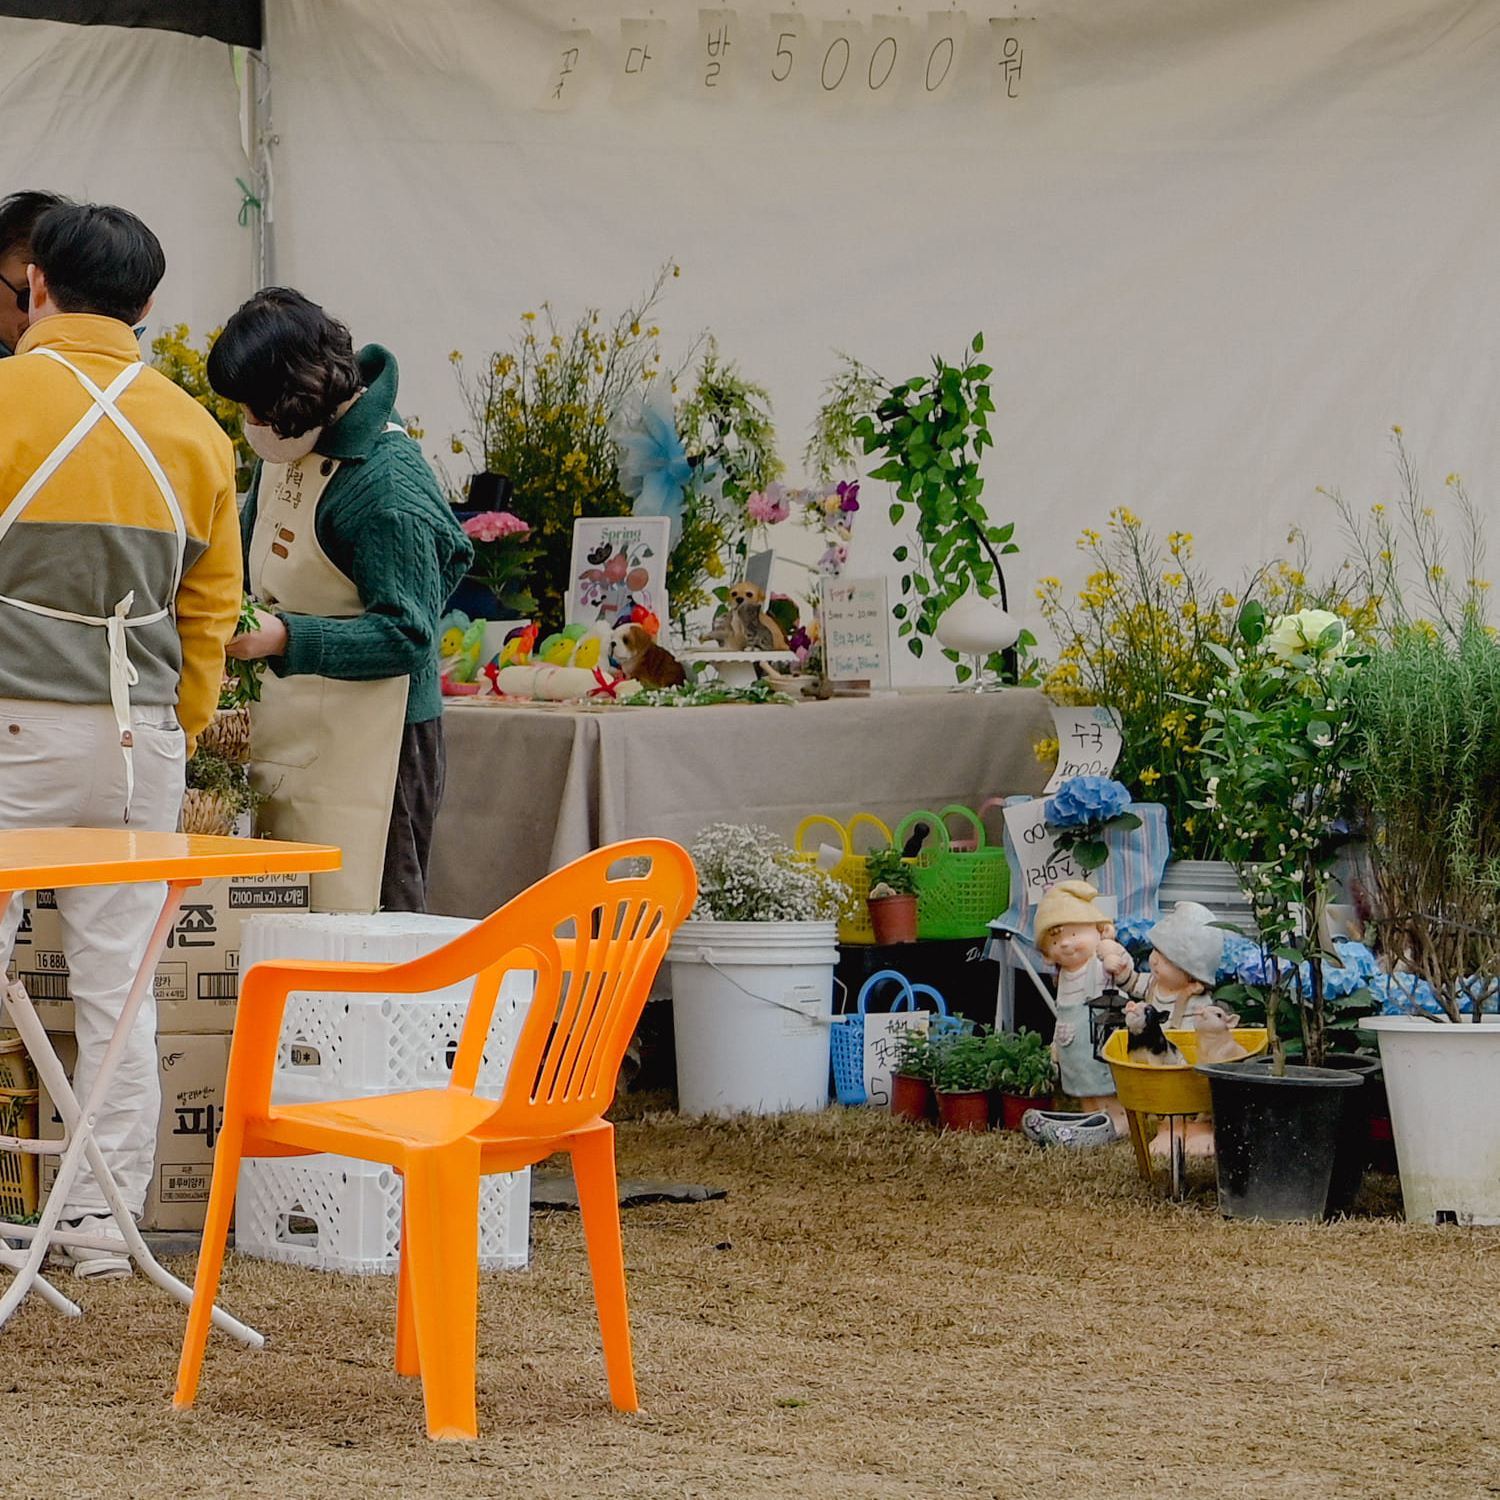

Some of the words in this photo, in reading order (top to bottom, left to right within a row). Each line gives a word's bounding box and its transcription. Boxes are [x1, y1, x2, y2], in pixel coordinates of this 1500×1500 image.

[601, 527, 642, 545] Spring
[1071, 722, 1104, 753] 수국
[172, 1103, 224, 1149] 피
